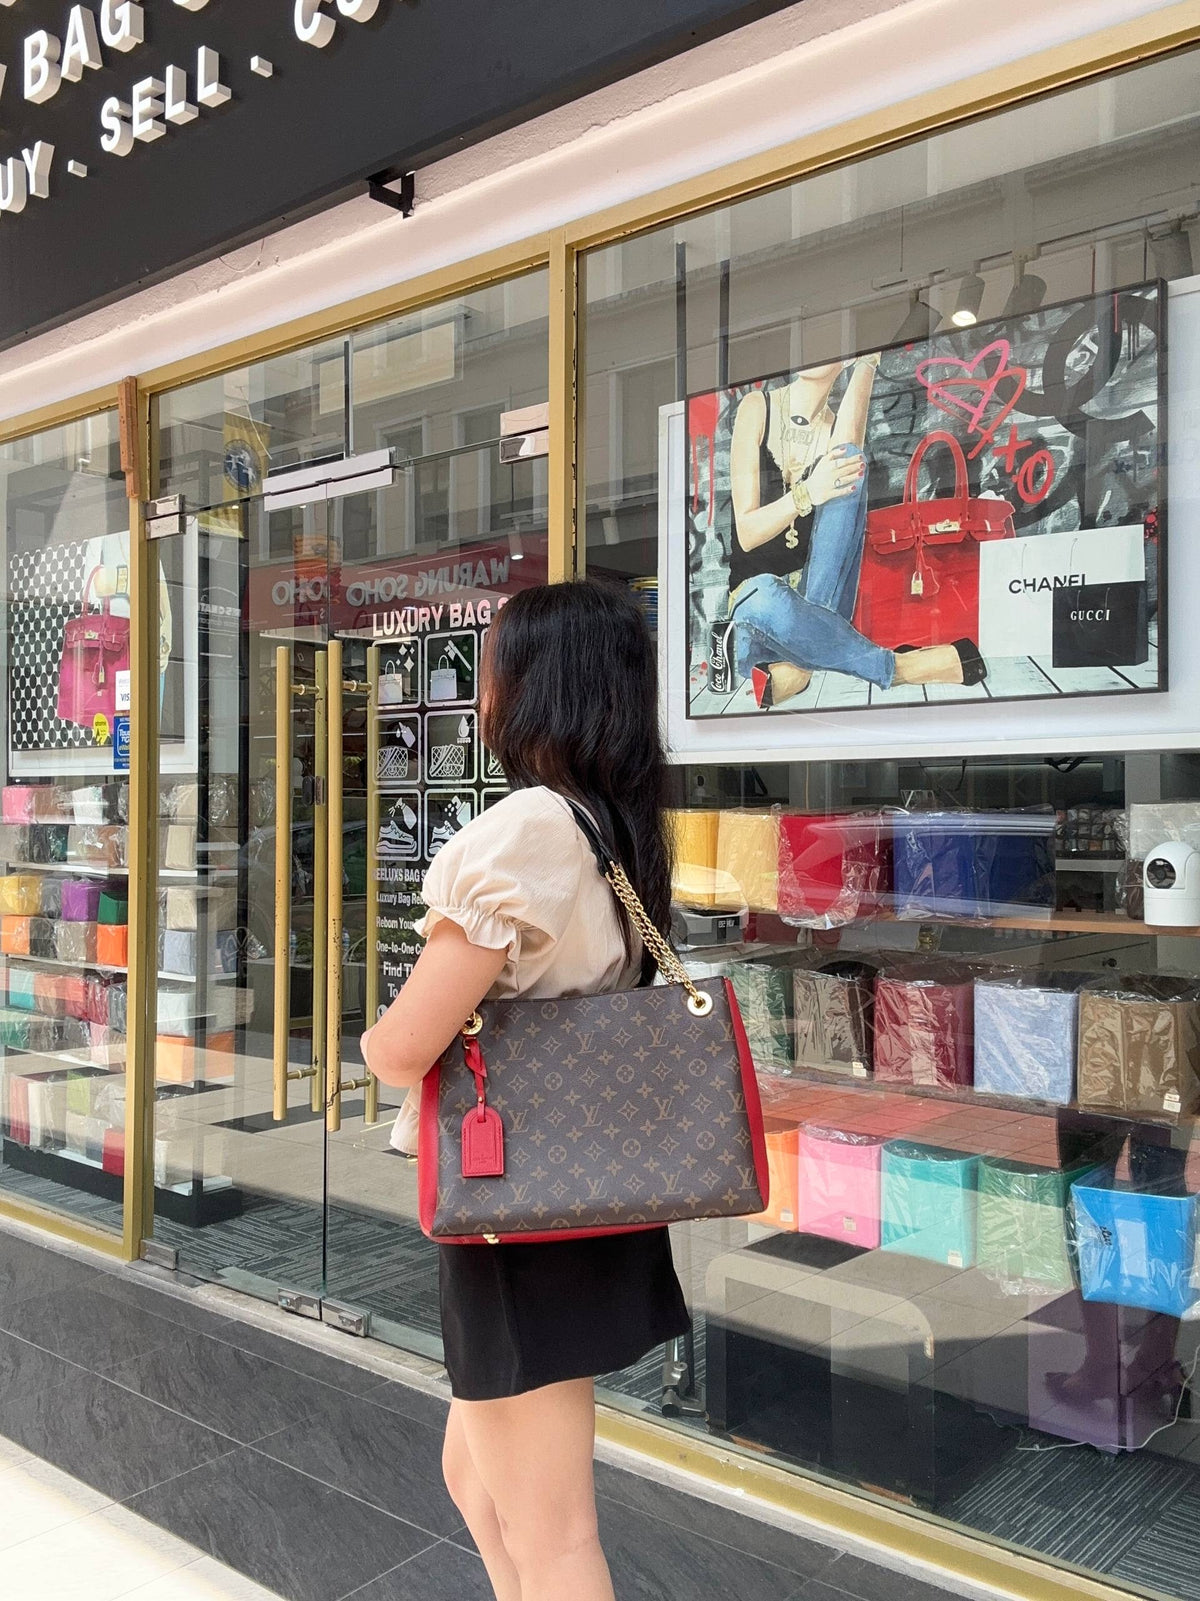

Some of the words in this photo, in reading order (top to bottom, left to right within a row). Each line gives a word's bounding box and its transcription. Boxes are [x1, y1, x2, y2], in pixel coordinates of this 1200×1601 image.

[24, 0, 144, 104] BAG
[101, 45, 231, 156] SELL
[372, 605, 443, 637] LUXURY
[449, 599, 491, 628] BAG
[1070, 609, 1111, 621] GUCCI
[404, 868, 420, 882] BAG
[376, 891, 397, 906] Luxury
[398, 892, 411, 906] Bag
[376, 940, 414, 954] One-to-One
[383, 961, 402, 978] Find
[387, 983, 399, 998] To
